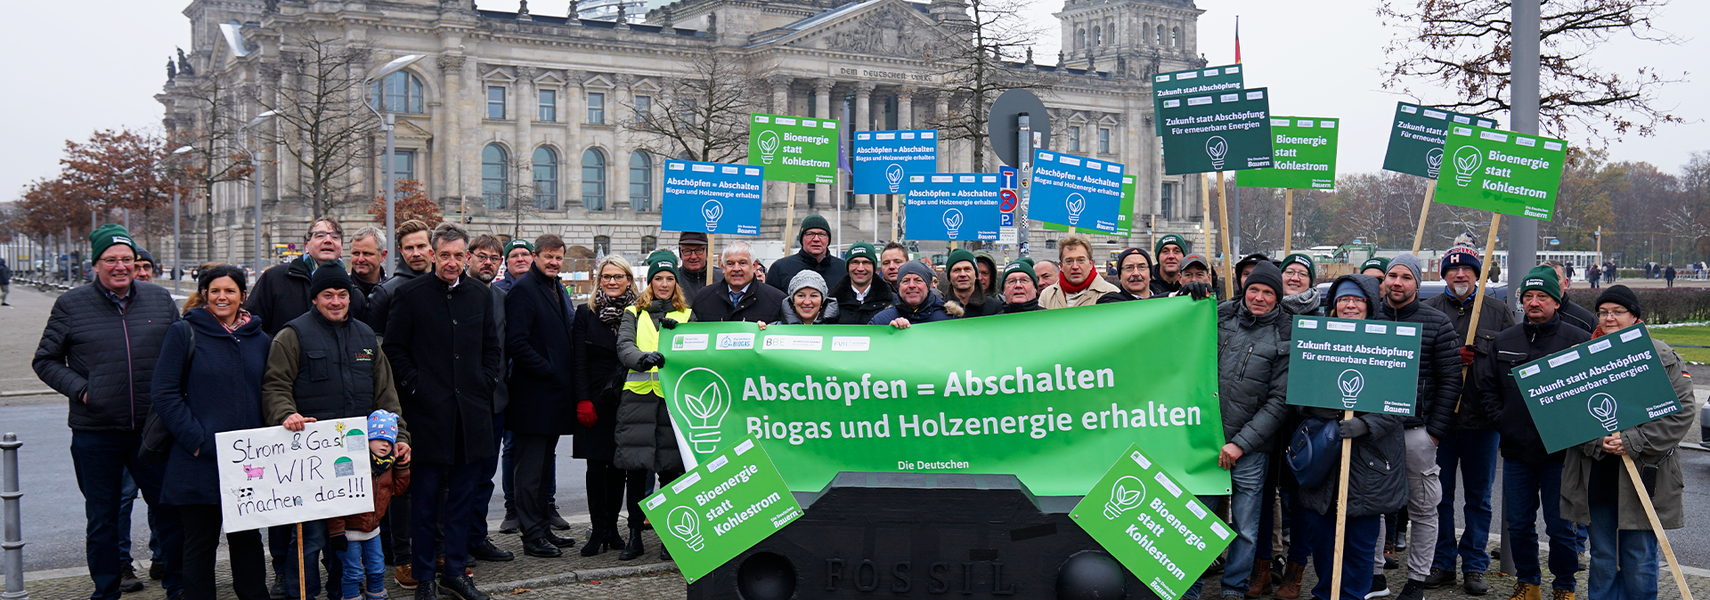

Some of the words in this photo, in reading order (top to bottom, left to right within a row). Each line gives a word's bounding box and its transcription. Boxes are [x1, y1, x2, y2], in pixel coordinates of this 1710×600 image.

[863, 70, 905, 80] DEUTSCHEN
[1157, 88, 1182, 96] Zukunft
[1183, 85, 1197, 94] statt
[1198, 82, 1240, 92] Abschöpfung
[1166, 116, 1195, 126] Zukunft
[1196, 114, 1213, 123] statt
[1215, 111, 1265, 122] Abschöpfung
[1184, 124, 1227, 133] erneuerbare
[1229, 121, 1260, 130] Energien
[1397, 121, 1425, 132] Zukunft
[1426, 127, 1442, 135] statt
[784, 133, 829, 145] Bioenergie
[1276, 134, 1327, 147] Bioenergie
[1412, 134, 1445, 144] erneuerba
[783, 145, 802, 154] statt
[1275, 148, 1297, 157] statt
[782, 156, 830, 168] Kohlestrom
[1274, 161, 1328, 171] Kohlestrom
[1488, 150, 1549, 170] Bioenergie
[1036, 167, 1076, 180] Abschöpfen
[1083, 175, 1120, 188] Abschalten
[1485, 166, 1511, 178] statt
[667, 178, 711, 187] Abschöpfen
[719, 181, 759, 190] Abschalten
[1034, 177, 1052, 186] Biogas
[1064, 182, 1096, 193] Holzenergie
[1097, 187, 1119, 196] erhalten
[1482, 179, 1547, 199] Kohlestrom
[699, 189, 734, 198] Holzenergie
[736, 191, 759, 199] erhalten
[909, 190, 950, 198] Abschöpfen
[1002, 215, 1009, 225] P
[1524, 210, 1548, 218] Bauern
[1450, 254, 1460, 264] H
[766, 338, 785, 346] BBE
[1297, 340, 1331, 350] Zukunft
[1333, 344, 1353, 353] statt
[1354, 345, 1414, 359] Abschöpfung
[1317, 354, 1368, 365] erneuerbare
[1369, 357, 1406, 369] Energien
[1528, 379, 1565, 398] Zukunft
[1566, 372, 1588, 385] statt
[1589, 350, 1652, 377] Abschöpfung
[742, 373, 908, 406] Abschöpfen
[917, 384, 934, 395] =
[944, 364, 1114, 397] Abschalten
[1539, 396, 1554, 406] Für
[1556, 379, 1608, 400] erneuerbare
[1609, 364, 1649, 382] Energien
[1384, 405, 1410, 414] Bauern
[1648, 405, 1677, 418] Bauern
[746, 415, 832, 445] Biogas
[840, 414, 890, 438] und
[899, 407, 1073, 439] Holzenergie
[1081, 401, 1200, 429] erhalten
[232, 438, 284, 463] Strom
[291, 433, 302, 450] &
[306, 430, 341, 450] Gas
[274, 456, 324, 484] WIR
[898, 461, 914, 470] Die
[917, 459, 969, 469] Deutschen
[695, 464, 758, 507] Bioenergie
[237, 489, 303, 516] machen
[315, 477, 365, 502] das!!!
[706, 499, 734, 522] statt
[713, 492, 781, 536] Kohlestrom
[773, 511, 798, 528] Bauern
[1138, 512, 1164, 537] statt
[1150, 497, 1206, 551] Bioenergie
[1125, 524, 1185, 581] Kohlestrom
[825, 557, 1016, 596] FOSSIL
[1150, 580, 1172, 600] Bauern
